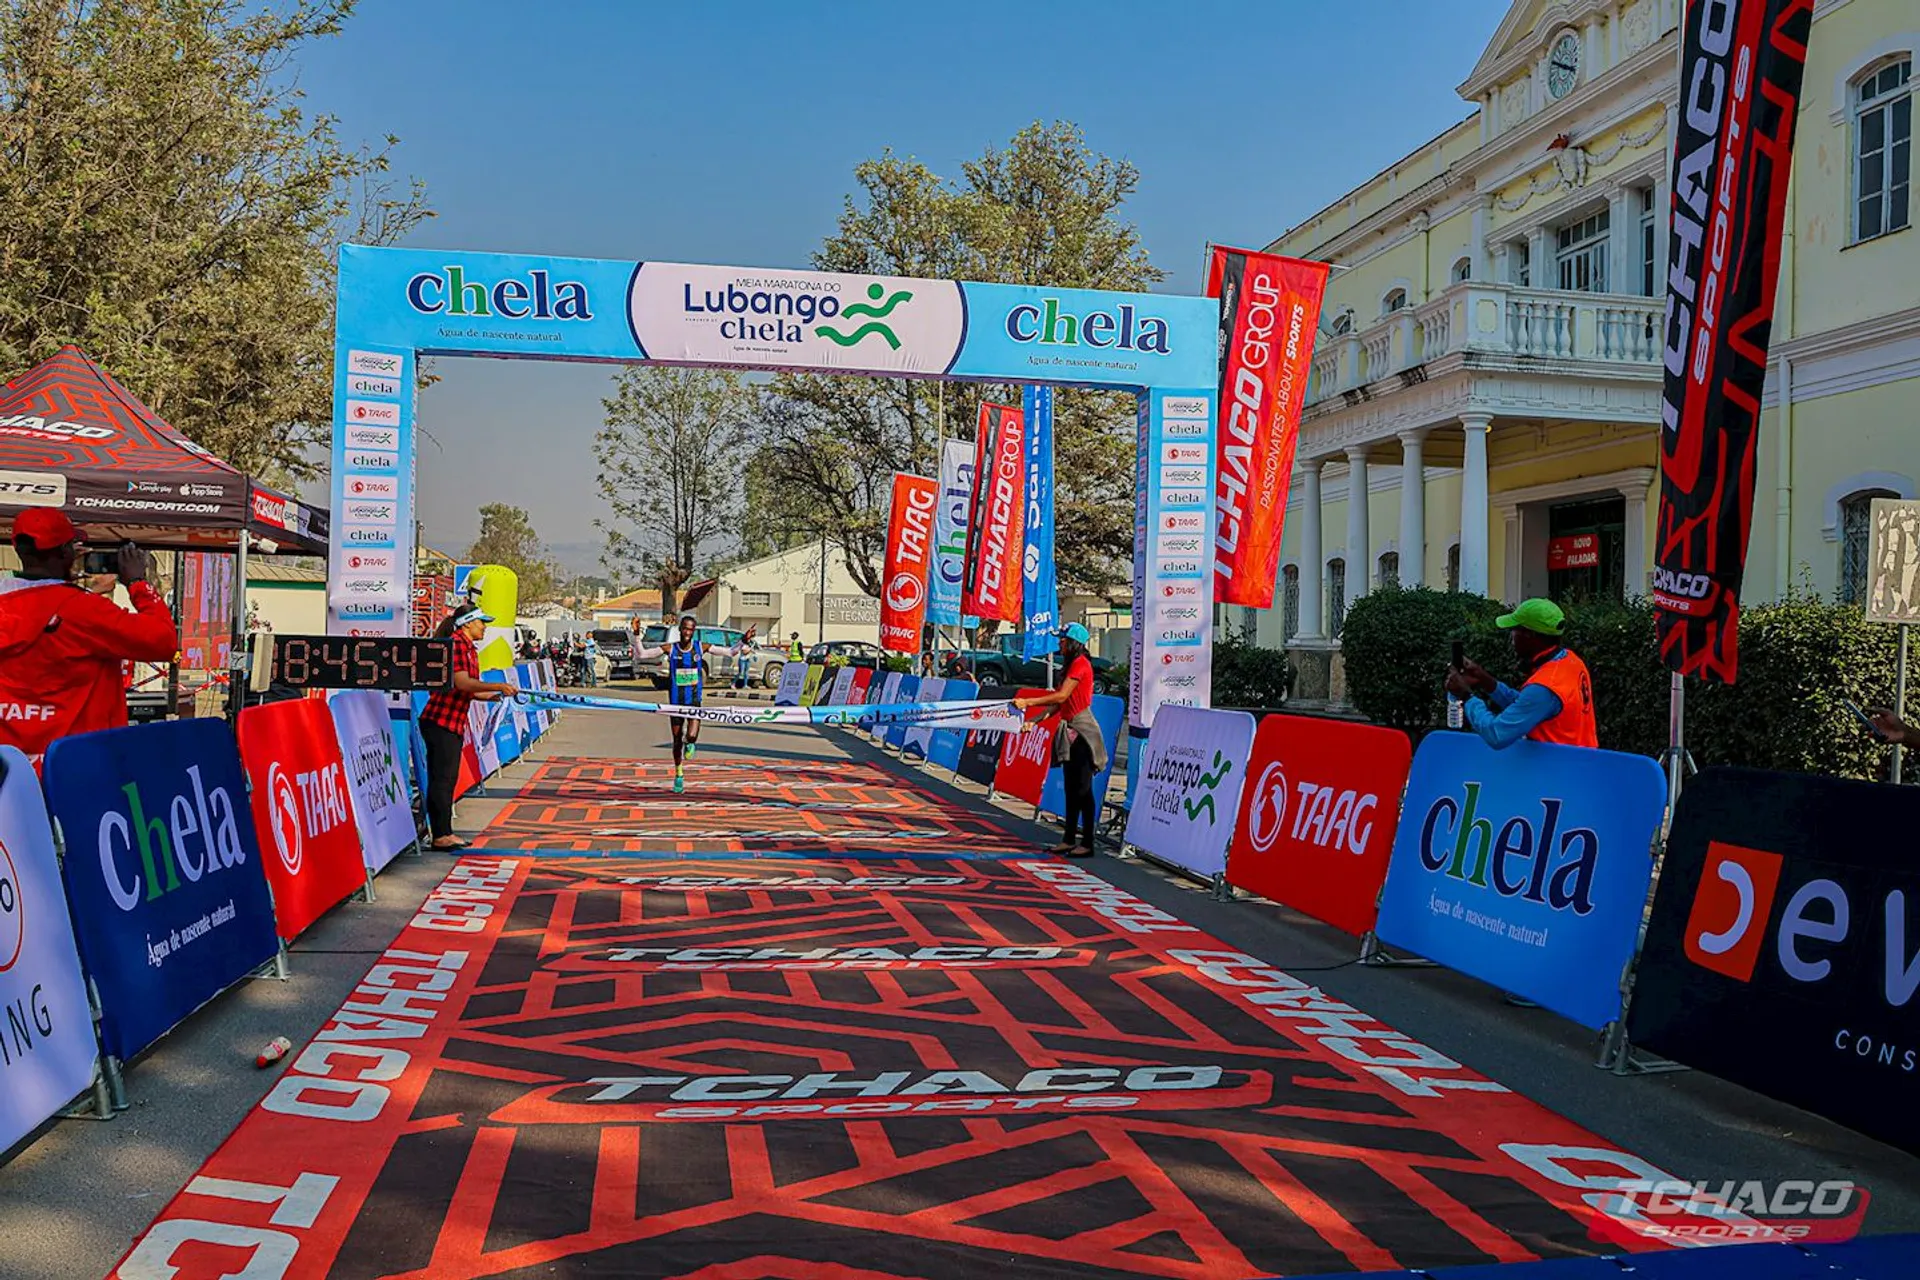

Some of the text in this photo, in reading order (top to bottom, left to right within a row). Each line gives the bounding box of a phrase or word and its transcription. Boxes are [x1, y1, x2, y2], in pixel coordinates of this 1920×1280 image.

[1694, 44, 1751, 385] SPORTS
[406, 267, 594, 321] chela
[736, 279, 841, 293] MEIA MARATONA DO
[684, 283, 840, 324] Lubango
[437, 326, 563, 342] Água de nascente natural
[720, 317, 804, 343] chela
[1005, 298, 1174, 355] chela
[1026, 355, 1138, 371] Água de nascente natural
[355, 381, 393, 394] chela
[1260, 304, 1305, 511] PASSIONATES ABOUT SPORTS
[1169, 424, 1202, 435] chela
[353, 455, 391, 468] chela
[75, 497, 221, 514] TCHACOSPORT.COM
[1167, 493, 1200, 503] chela
[350, 531, 388, 541] chela
[896, 487, 936, 564] TAAG
[939, 463, 975, 584] chela
[1163, 562, 1197, 572] chela
[1567, 552, 1598, 566] PALADAR
[345, 604, 386, 614] chela
[1163, 630, 1196, 640] chela
[1147, 749, 1201, 796] Lubango
[296, 762, 347, 839] TAAG
[1151, 785, 1181, 816] chela
[1291, 781, 1379, 855] TAAG
[99, 764, 246, 912] chela
[1419, 781, 1599, 918] chela
[409, 860, 519, 933] TCHACO
[147, 899, 236, 968] Água de nascente natural
[1428, 886, 1549, 949] Água de nascente natural
[605, 947, 1063, 962] TCHACO
[260, 949, 471, 1122] TCHACO
[584, 1065, 1226, 1102] TCHACO
[655, 1096, 1141, 1118] SPORTS
